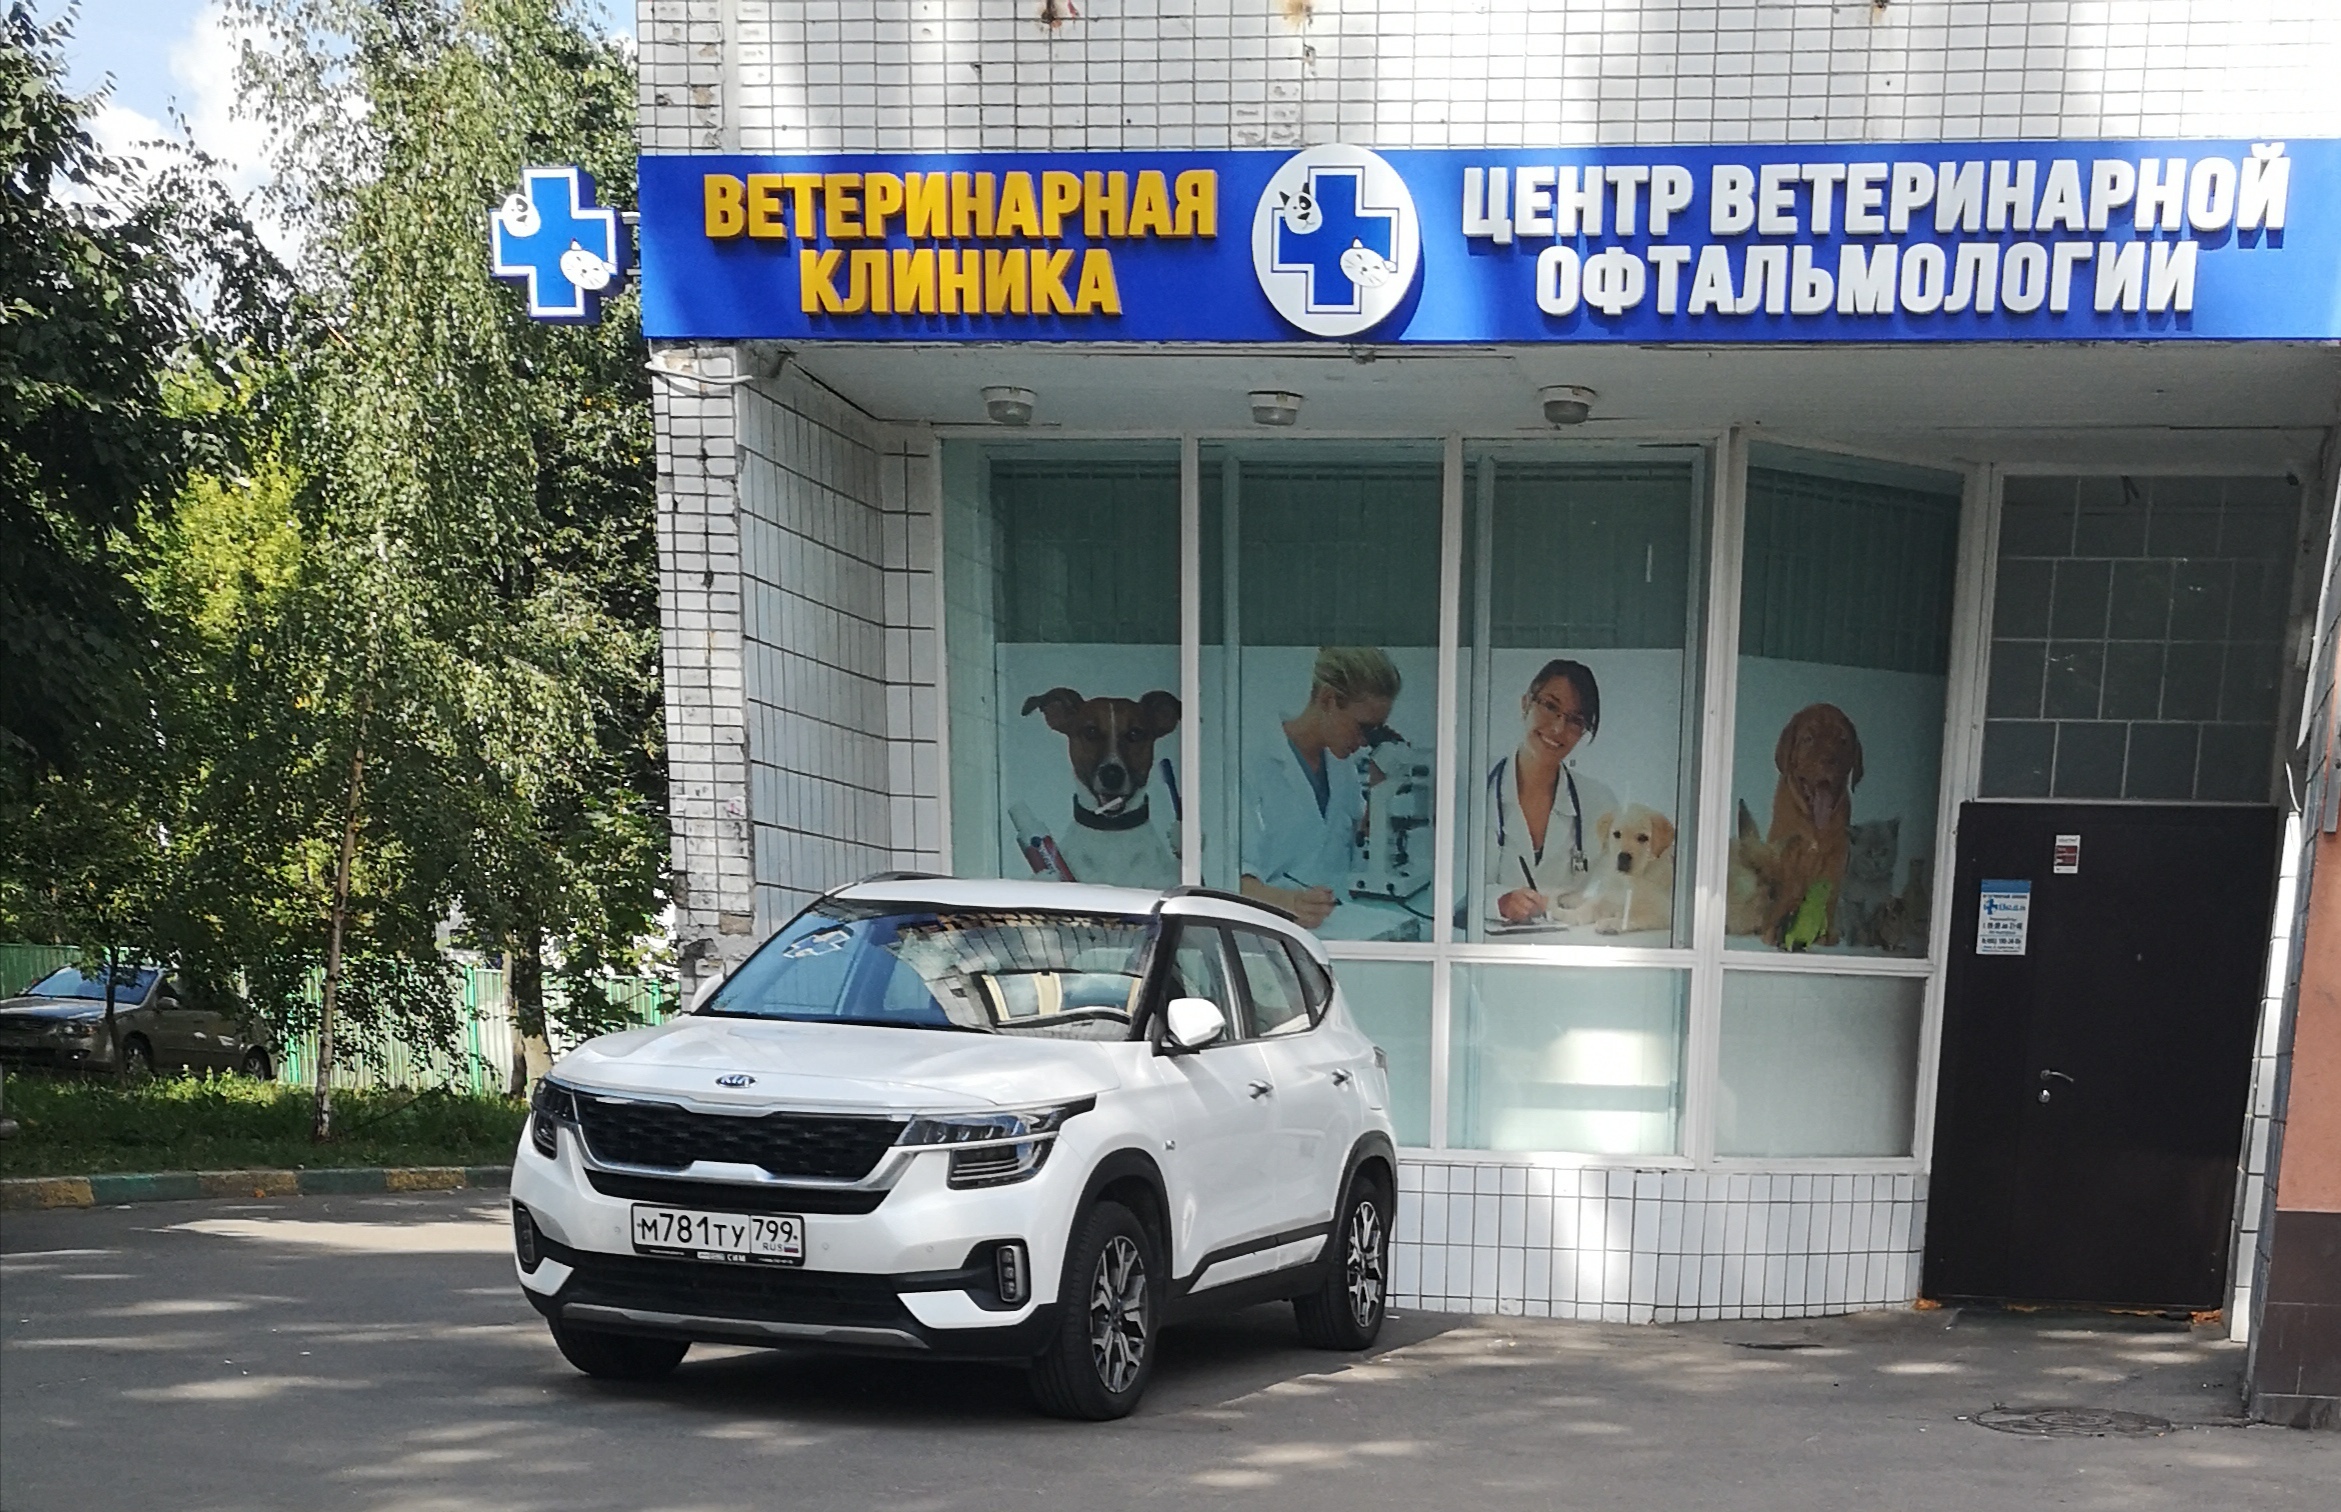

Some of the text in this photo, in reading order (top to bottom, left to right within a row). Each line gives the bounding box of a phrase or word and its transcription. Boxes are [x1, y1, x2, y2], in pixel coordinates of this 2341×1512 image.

[703, 170, 1219, 240] ВЕТЕРИНАРНАЯ
[1462, 142, 2291, 244] ЦЕНТР ВЕТЕРИНАРНОЙ
[800, 248, 1122, 316] КЛИНИКА
[1536, 242, 2196, 317] ОФТАЛЬМОЛОГИИ
[752, 1218, 793, 1242] 799
[762, 1242, 783, 1252] RUS
